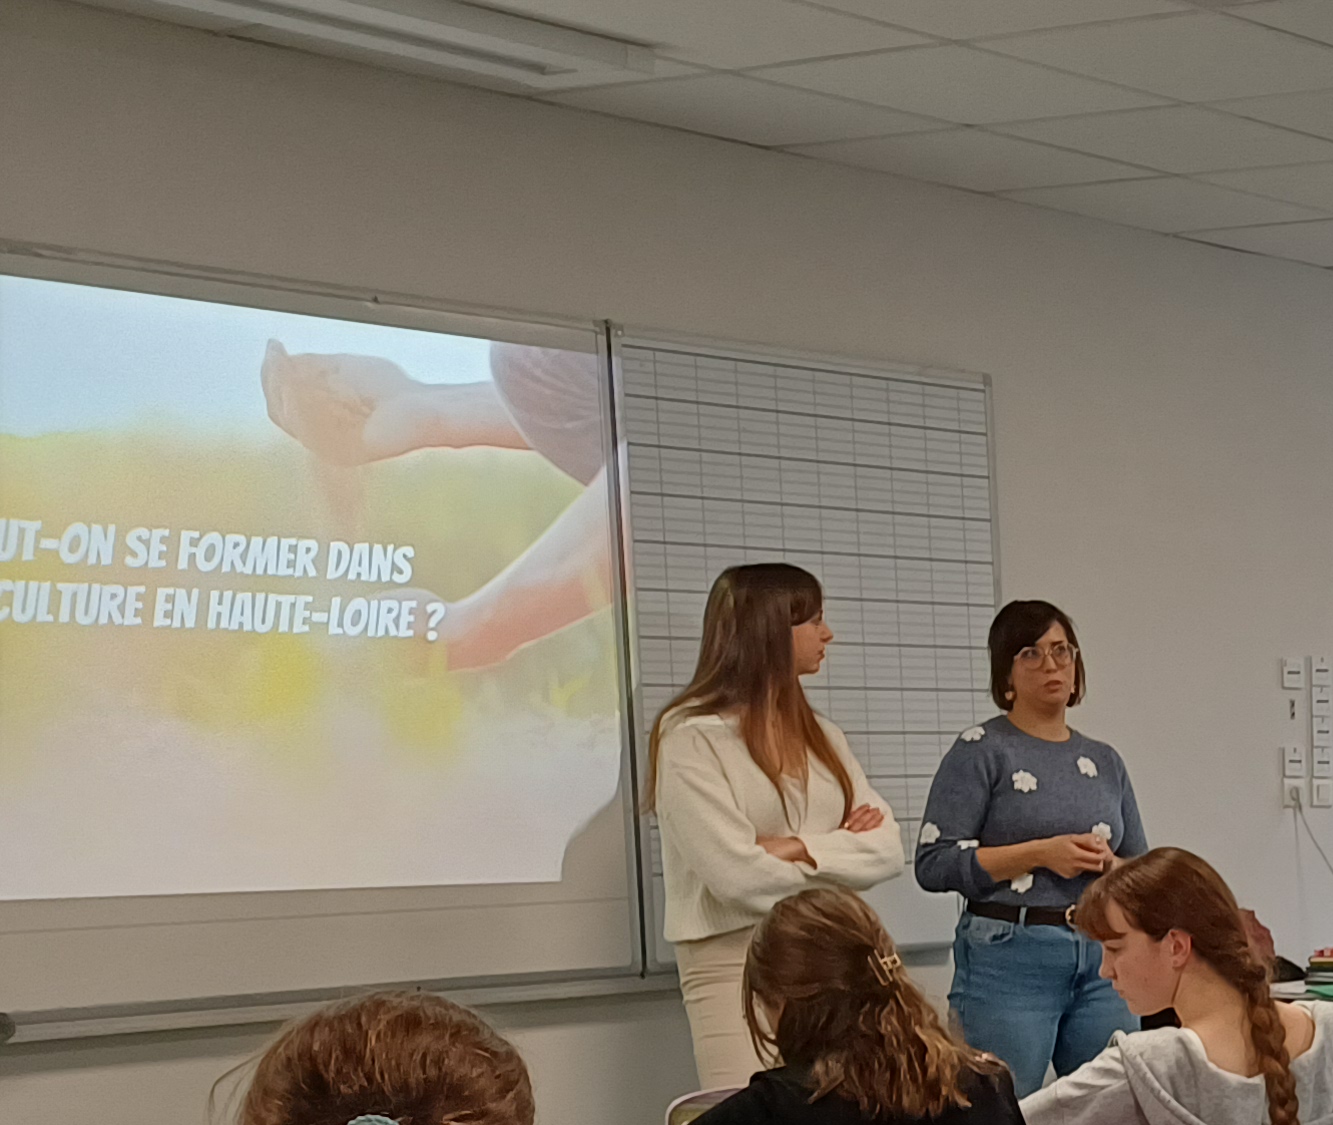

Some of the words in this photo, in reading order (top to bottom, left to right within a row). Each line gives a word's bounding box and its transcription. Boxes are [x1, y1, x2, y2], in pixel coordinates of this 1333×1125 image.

[0, 518, 116, 566] UT-ON
[125, 527, 170, 568] SE
[177, 530, 319, 578] FORMER
[326, 541, 414, 584] DANS
[153, 587, 199, 628] EN
[207, 589, 418, 638] HAUTE-LOIRE
[426, 602, 446, 643] ?
